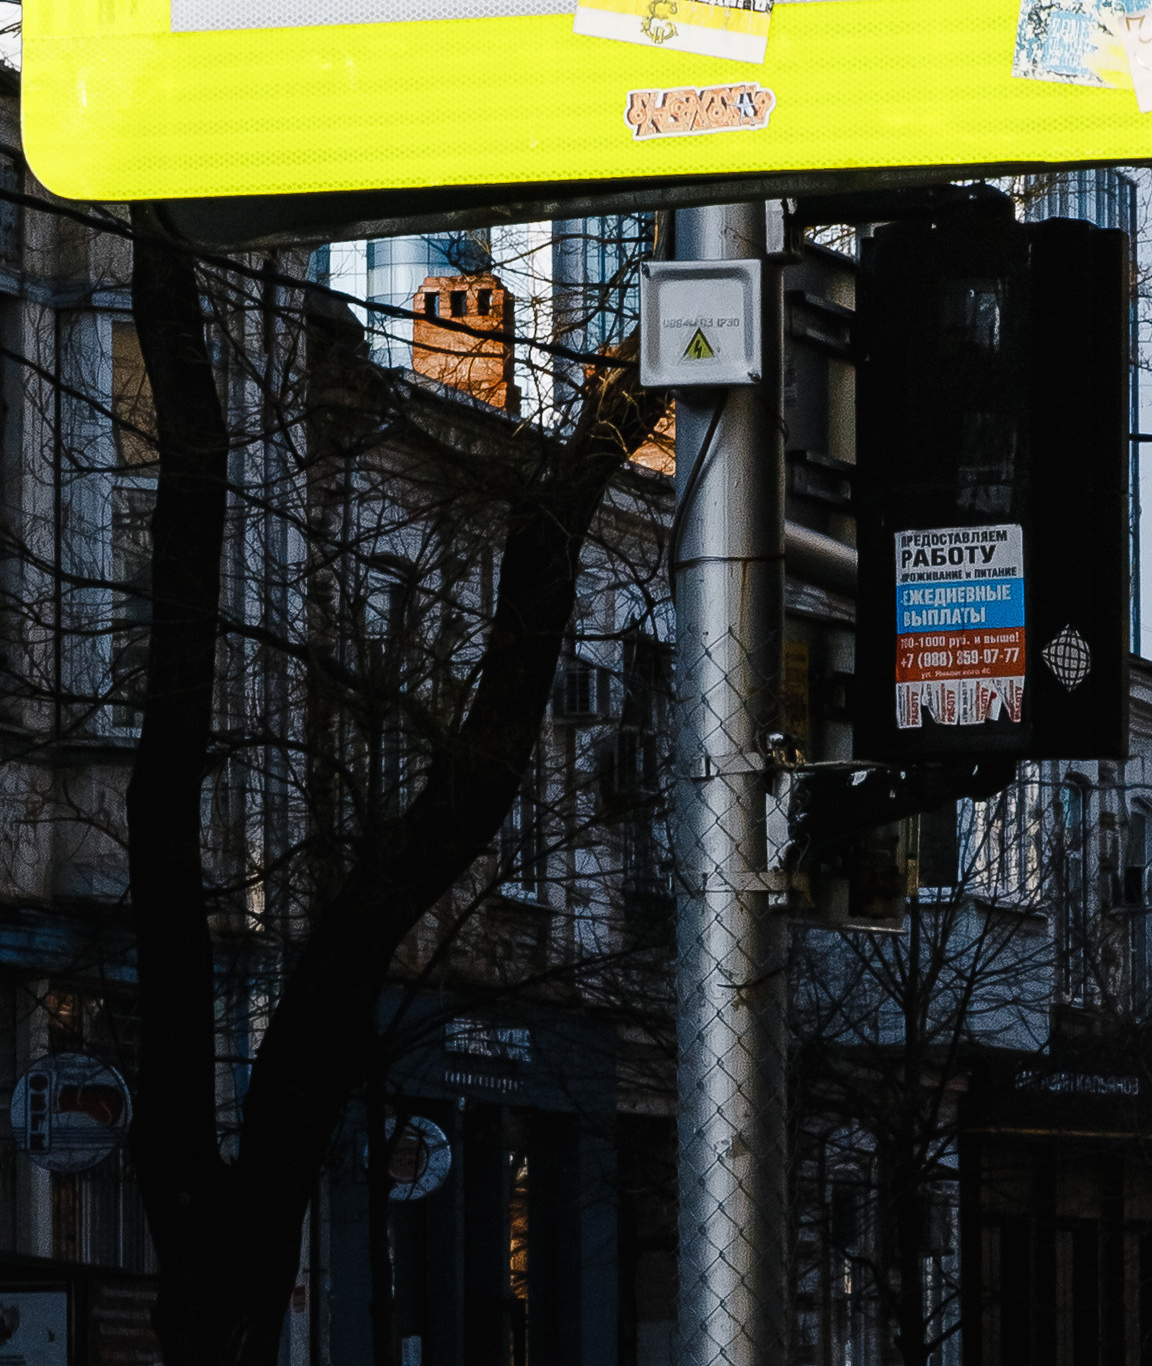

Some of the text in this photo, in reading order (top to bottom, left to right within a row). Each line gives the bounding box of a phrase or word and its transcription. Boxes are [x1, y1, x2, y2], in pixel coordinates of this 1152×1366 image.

[901, 530, 1008, 548] ПРЕДОСТАВЛЯЕМ
[902, 544, 996, 569] РАБОТУ
[900, 569, 962, 583] ПРОЖИВАНИЕ
[974, 566, 1017, 579] ПИТАНИЕ
[902, 584, 1011, 607] ЕЖЕДНЕВНЫЕ
[903, 607, 986, 627] ВЫПЛАТЫ
[983, 631, 1020, 644] выше!
